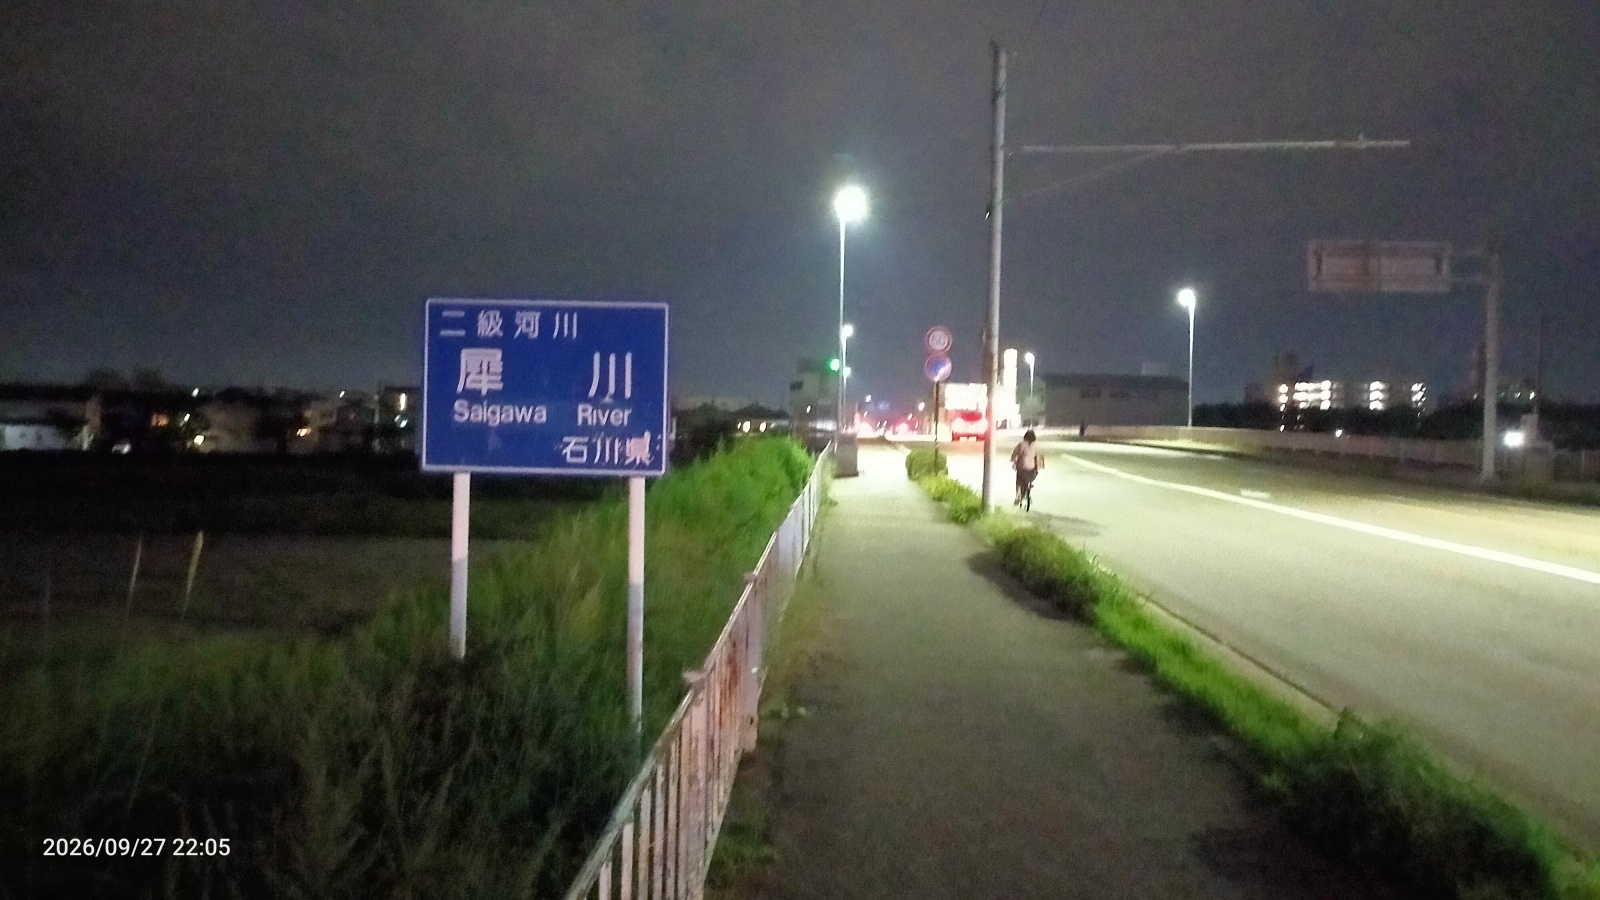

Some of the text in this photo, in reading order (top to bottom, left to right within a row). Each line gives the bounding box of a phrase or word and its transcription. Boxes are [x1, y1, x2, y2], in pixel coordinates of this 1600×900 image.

[440, 310, 578, 340] 二級河川
[453, 399, 632, 426] Saigawa River
